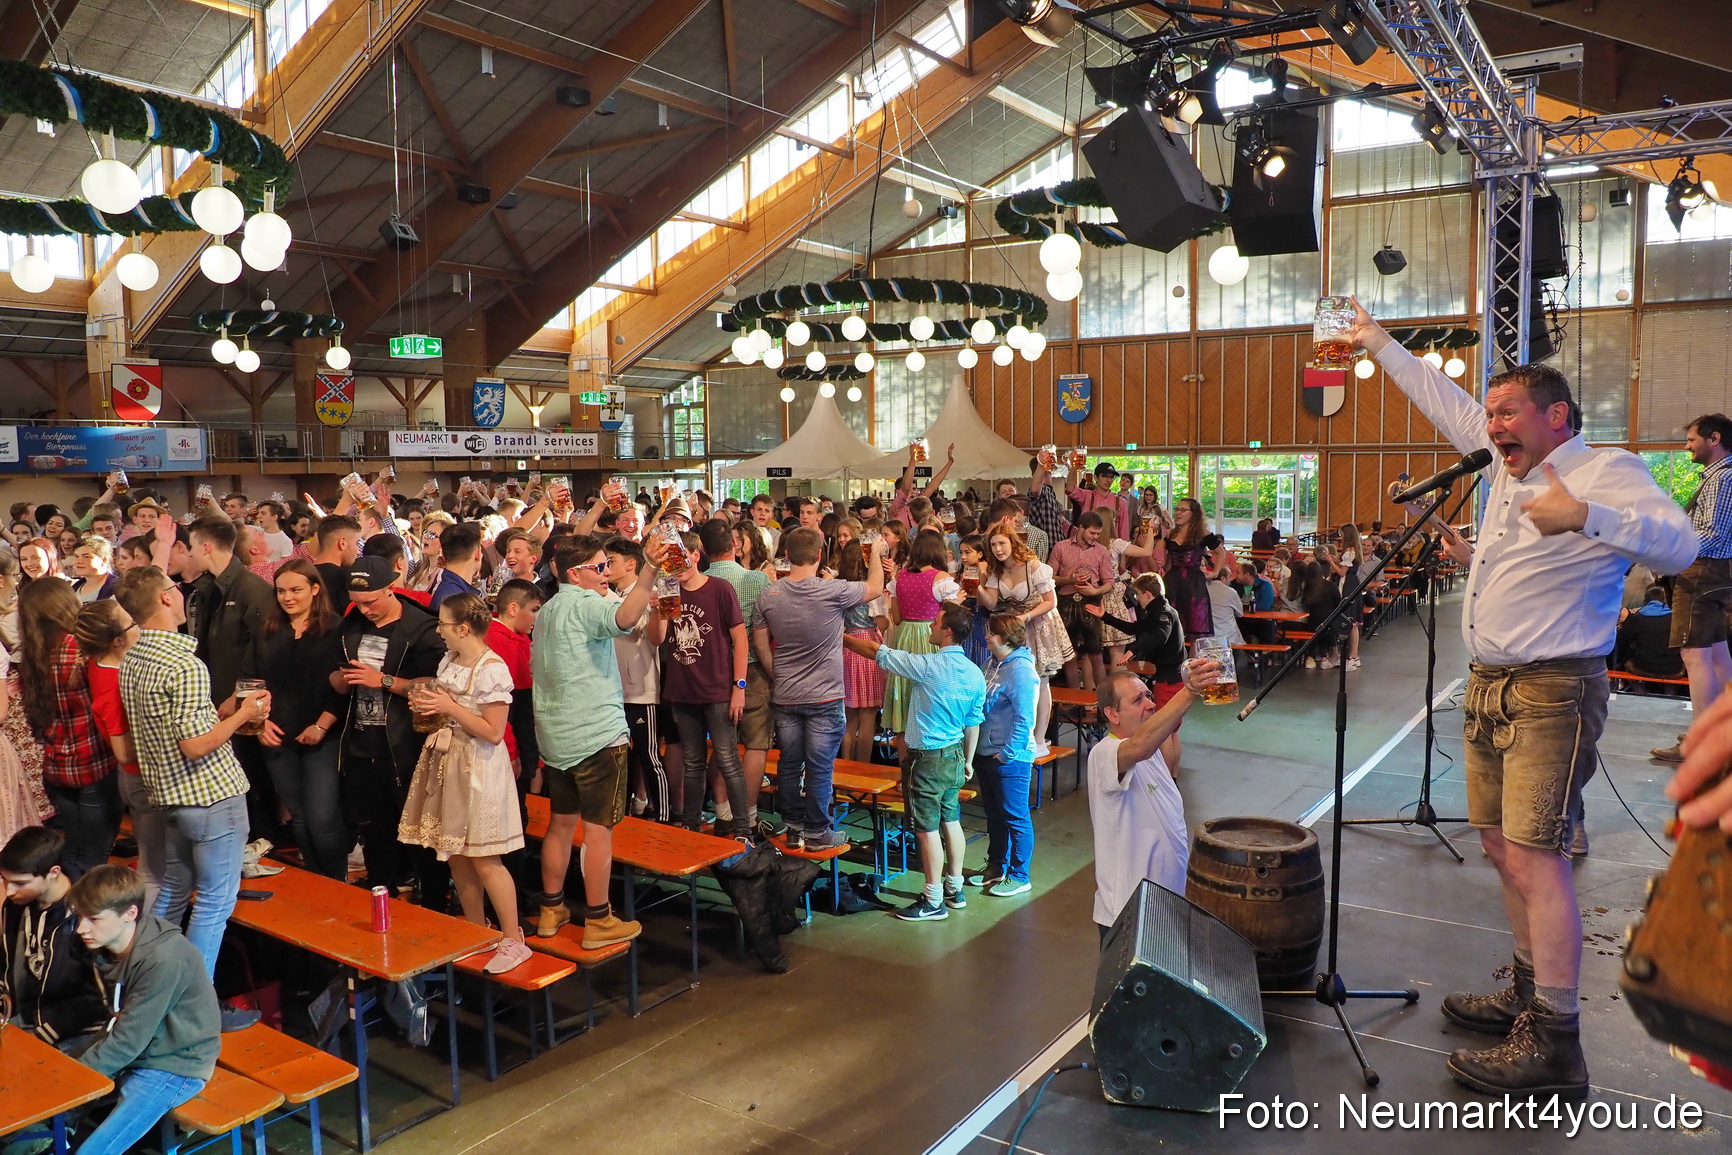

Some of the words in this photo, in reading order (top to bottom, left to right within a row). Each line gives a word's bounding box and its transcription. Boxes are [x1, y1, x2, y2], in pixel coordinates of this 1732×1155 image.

[24, 431, 39, 440] Der
[40, 431, 77, 443] hochfeine
[114, 433, 139, 441] Wasser
[140, 435, 156, 444] zum
[395, 433, 449, 443] NEUMARKT
[494, 434, 537, 446] Brandl
[544, 435, 594, 446] services
[45, 442, 87, 454] Biergenuss
